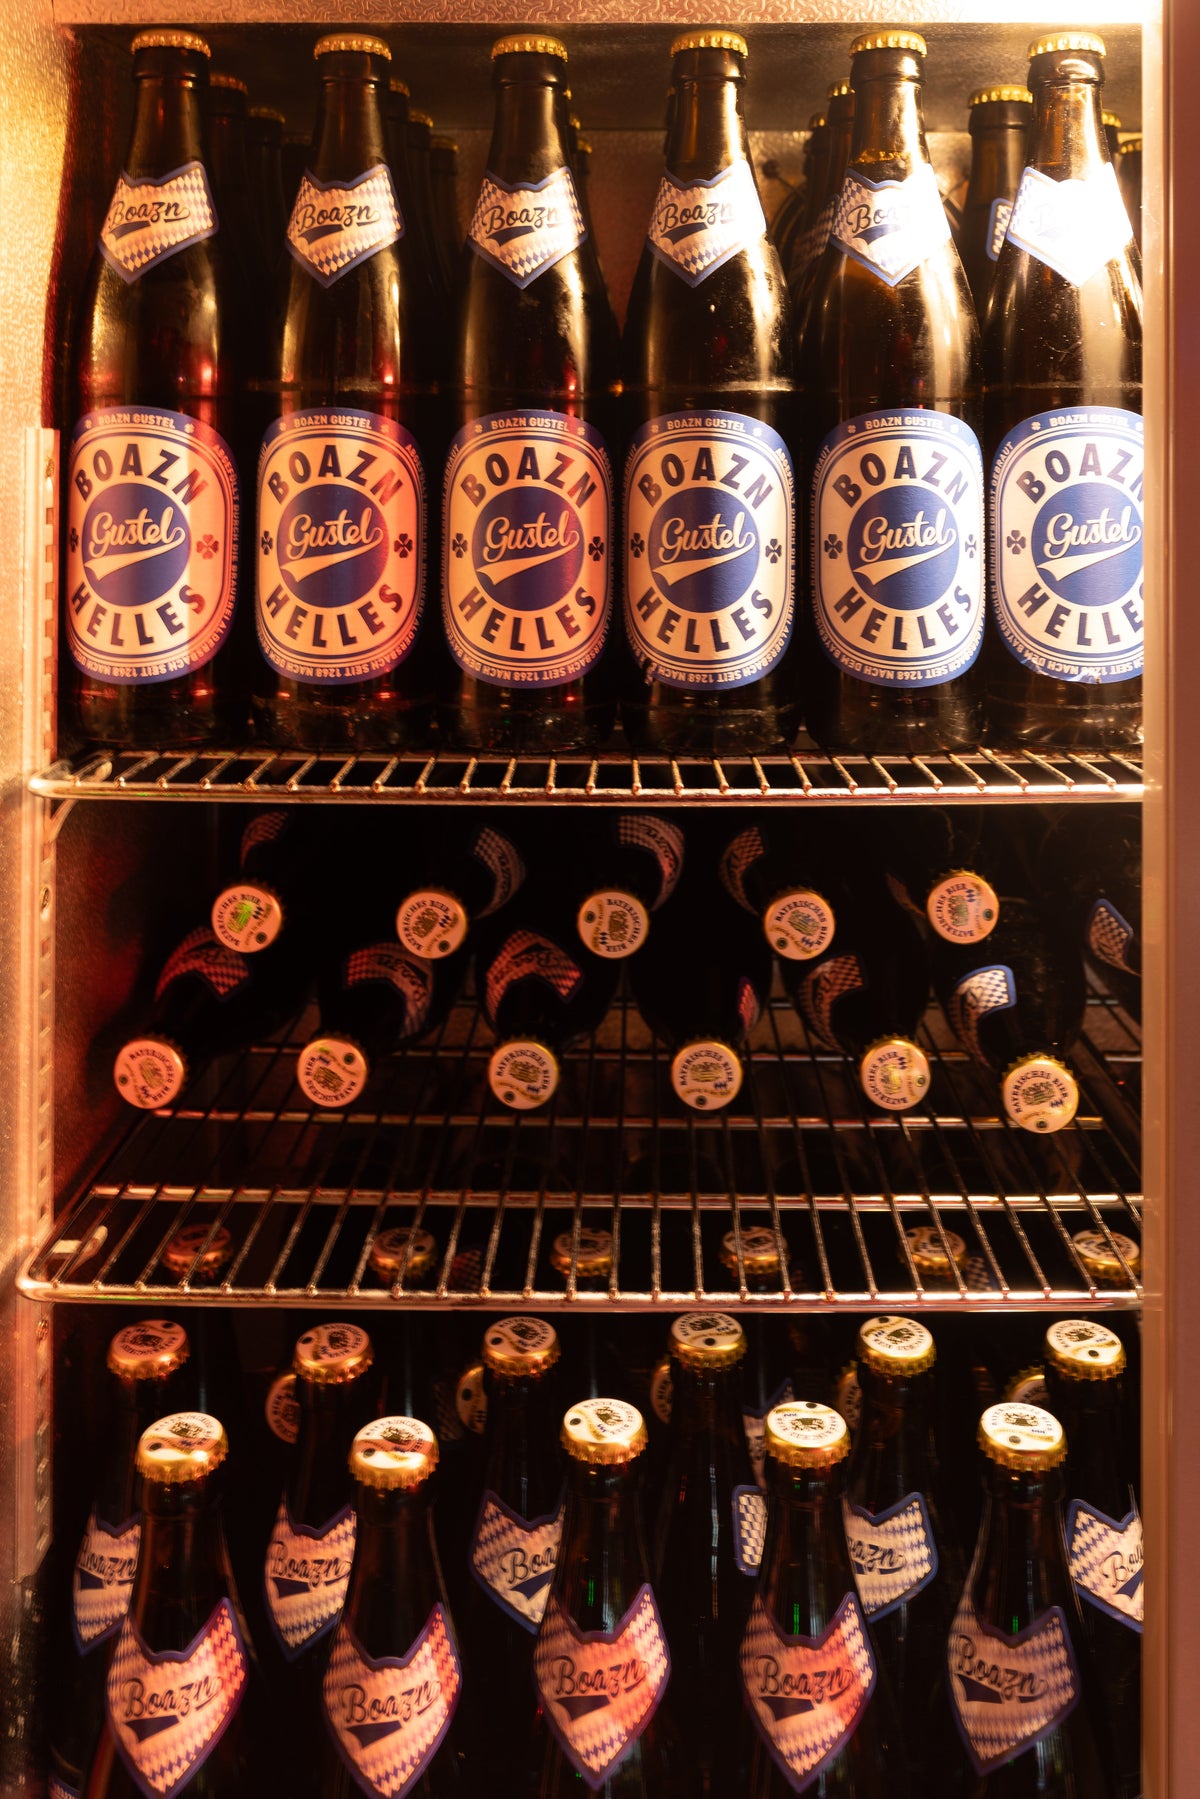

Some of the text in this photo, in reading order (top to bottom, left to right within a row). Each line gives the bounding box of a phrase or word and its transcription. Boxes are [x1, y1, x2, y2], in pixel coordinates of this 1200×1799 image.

[108, 200, 190, 226] Boazn
[299, 203, 381, 228] Boazn
[482, 205, 560, 233] Boazn
[133, 414, 176, 429] GUSTEL
[294, 415, 372, 429] BOAZN GUSTEL
[491, 417, 569, 432] BOAZN GUSTEL
[667, 418, 746, 432] BOAZN GUSTEL
[865, 416, 944, 429] BOAZN GUSTEL
[1049, 414, 1087, 427] BOAZN
[75, 444, 208, 506] BOAZN
[268, 445, 403, 506] BOAZN
[460, 447, 597, 509] BOAZN
[832, 445, 969, 508] BOAZN
[991, 441, 1014, 487] GEBRAUT
[637, 447, 774, 510] BOAZN
[89, 507, 185, 558] Gustel
[286, 507, 383, 559] Gustel
[482, 510, 580, 563] Gustel
[658, 511, 755, 564] Gustel
[860, 508, 956, 563] Gustel
[1043, 505, 1141, 558] Gustel
[71, 581, 205, 647] HELLES
[266, 584, 403, 648] HELLES
[458, 586, 596, 651] HELLES
[636, 586, 772, 653] HELLES
[834, 585, 971, 650] HELLES
[1017, 582, 1144, 646] HELLE
[140, 664, 166, 677] SEIT
[287, 663, 313, 676] NACH
[344, 663, 369, 676] SEIT
[483, 665, 511, 680] NACH
[513, 671, 539, 681] 1268
[542, 667, 566, 680] SEIT
[658, 666, 686, 681] NACH
[717, 670, 742, 682] SEIT
[840, 655, 862, 671] DEM
[864, 665, 894, 679] NACH
[897, 670, 922, 680] 1268
[925, 666, 949, 678] SEIT
[1048, 661, 1079, 674] NACH
[1109, 661, 1133, 674] SEIT
[687, 673, 714, 683] 1268
[945, 883, 968, 894] BIER
[775, 900, 826, 922] BAYERISCHES
[267, 1540, 352, 1587] Boazn
[502, 1545, 559, 1584] Boa
[552, 1655, 649, 1697] Boazn
[753, 1654, 854, 1702] Boazn
[958, 1634, 1050, 1700] Boazn
[121, 1675, 223, 1717] Boazn
[342, 1680, 441, 1722] Boazn
